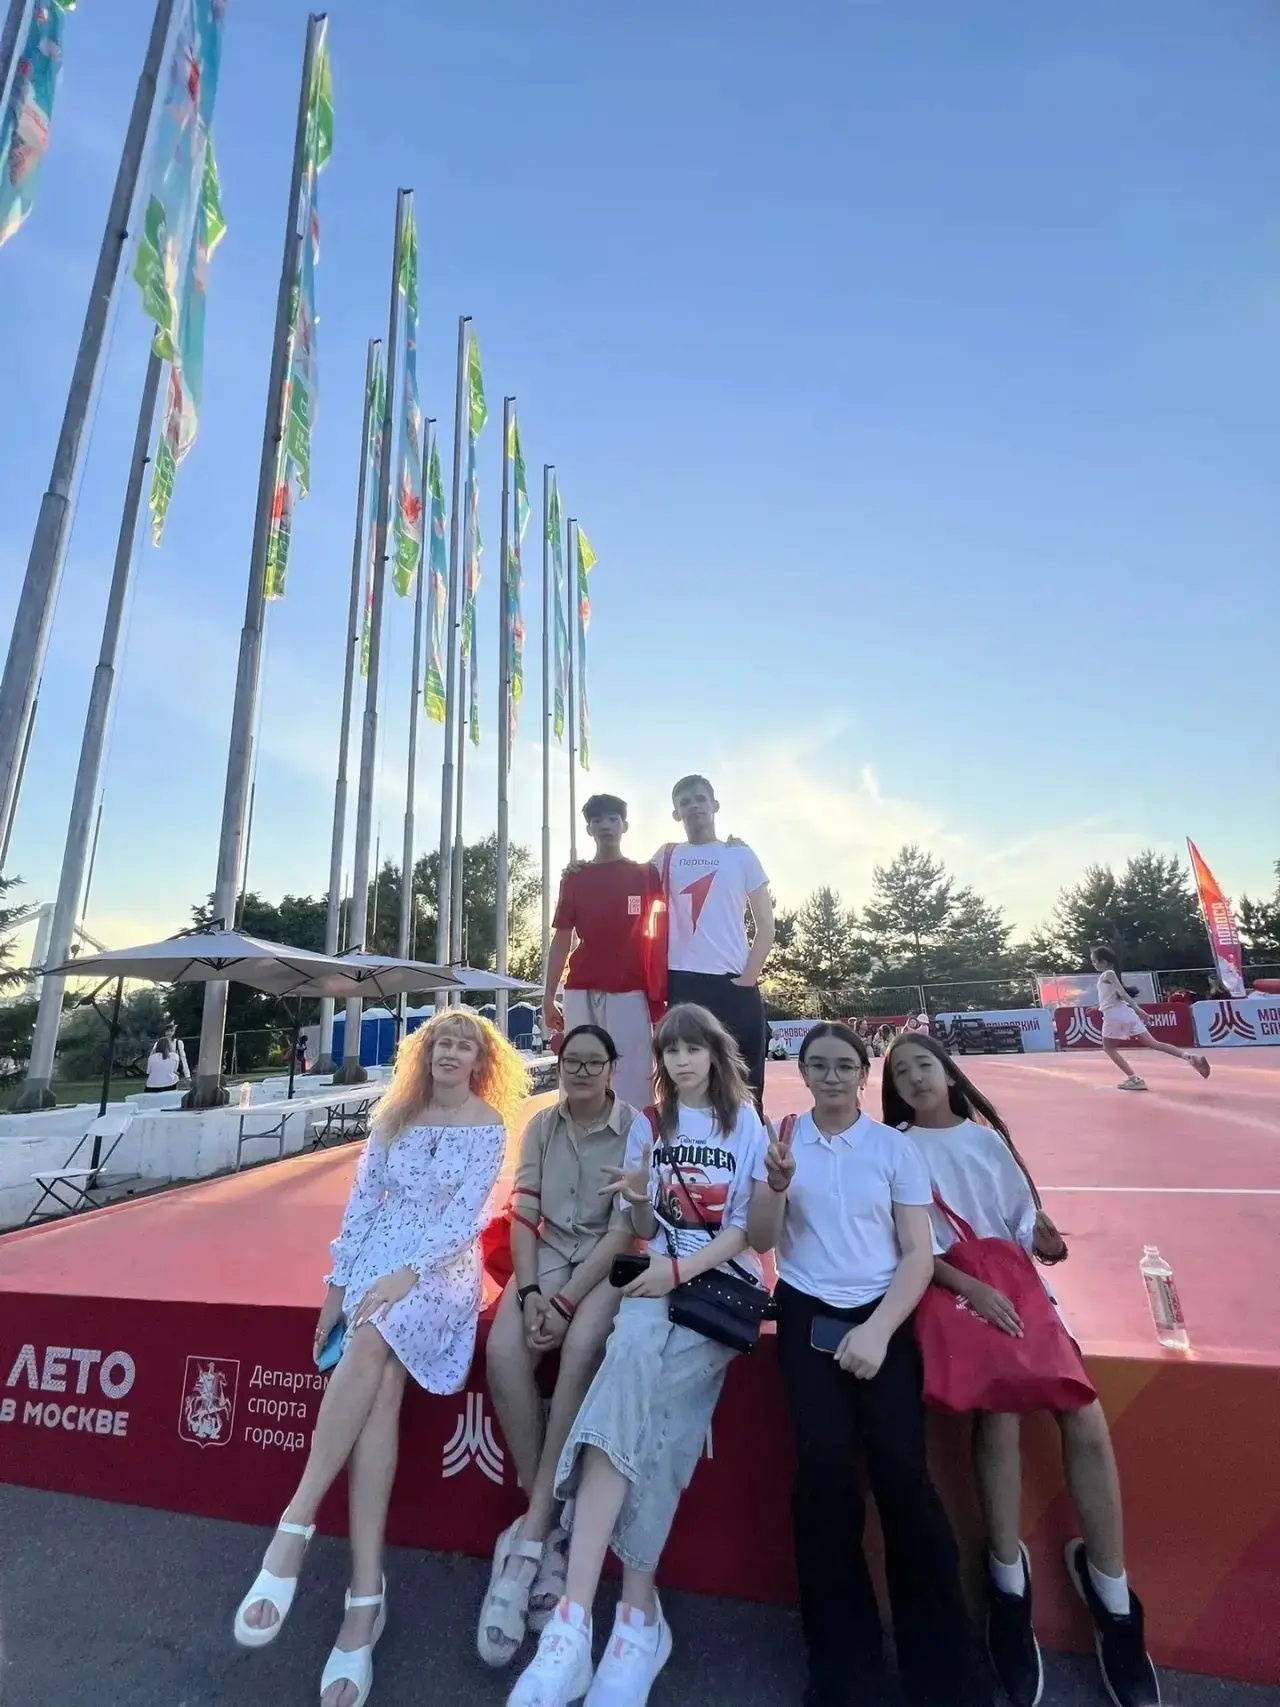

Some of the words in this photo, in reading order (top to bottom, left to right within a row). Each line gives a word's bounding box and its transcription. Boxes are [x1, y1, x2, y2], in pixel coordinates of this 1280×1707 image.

[1257, 1008, 1280, 1021] МО
[1260, 1022, 1280, 1035] СП
[5, 1344, 136, 1399] ЛЕТО
[0, 1398, 17, 1422] В
[22, 1401, 130, 1437] МОСКВЕ
[248, 1397, 307, 1421] спорта
[244, 1426, 305, 1452] города
